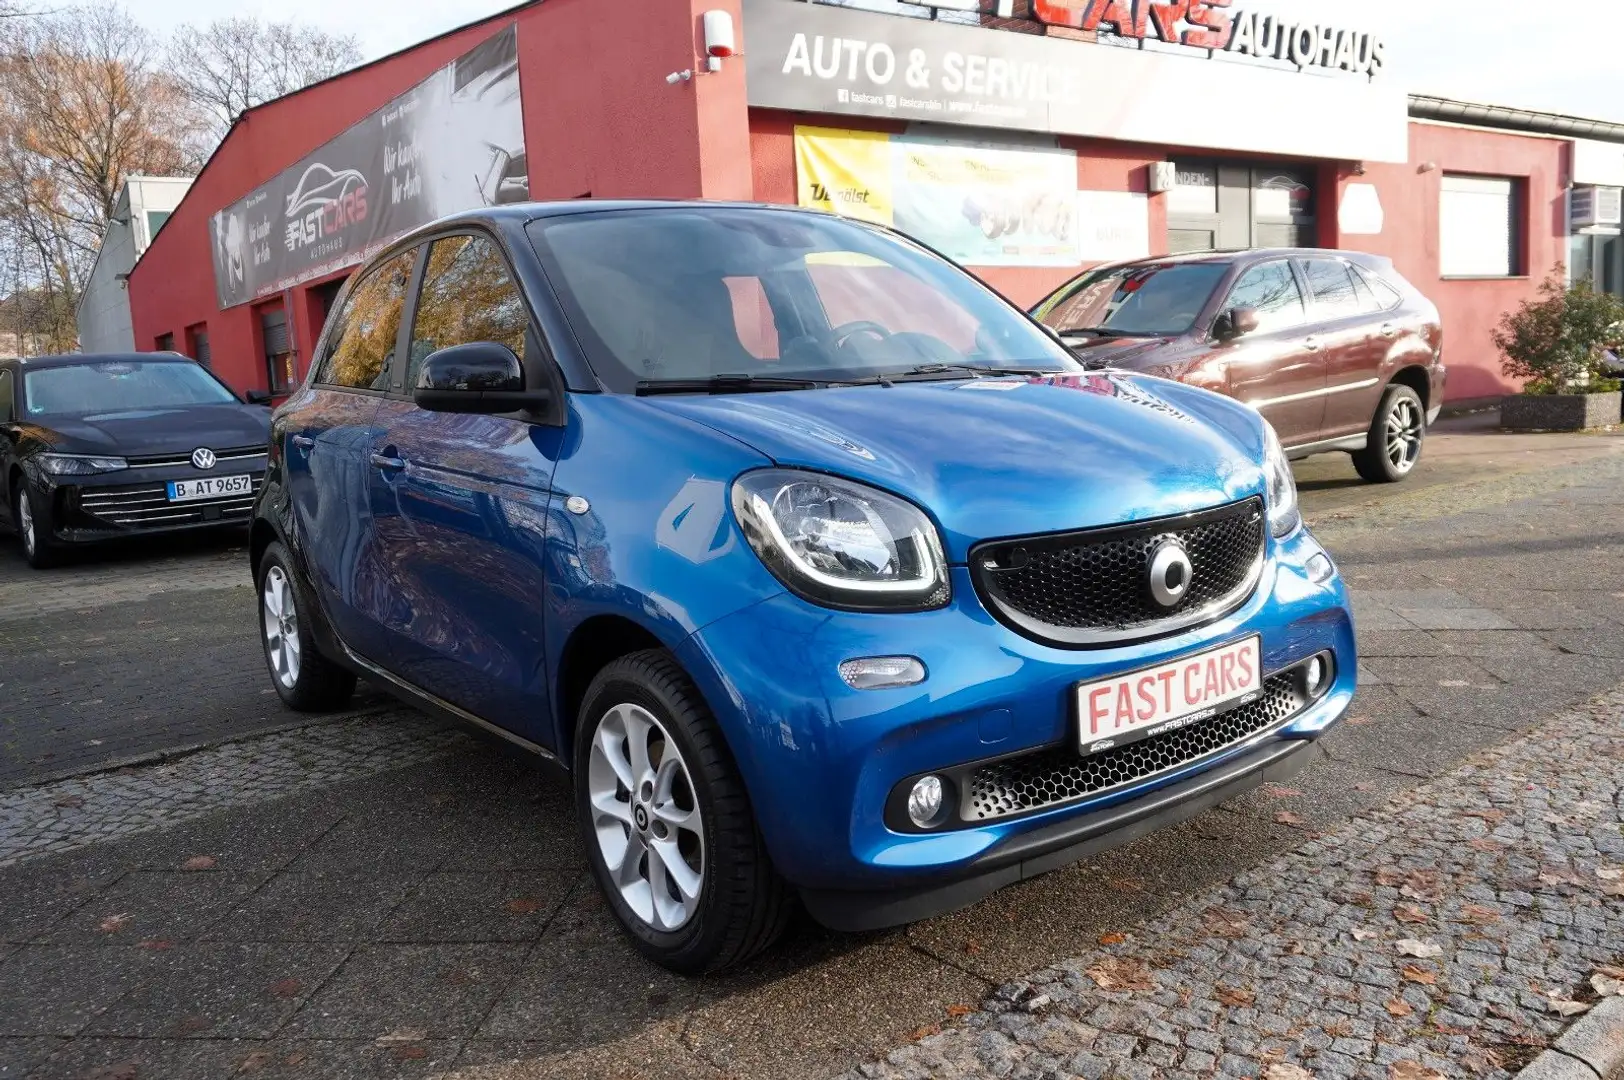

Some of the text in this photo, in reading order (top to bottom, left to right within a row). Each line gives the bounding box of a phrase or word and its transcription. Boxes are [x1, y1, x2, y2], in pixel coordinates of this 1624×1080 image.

[782, 33, 1080, 104] AUTO & SERVICE
[1229, 9, 1384, 78] AUTOHAUS
[1175, 171, 1210, 185] NDEN-
[176, 476, 249, 497] B AT 9657
[1089, 646, 1252, 734] FAST CARS
